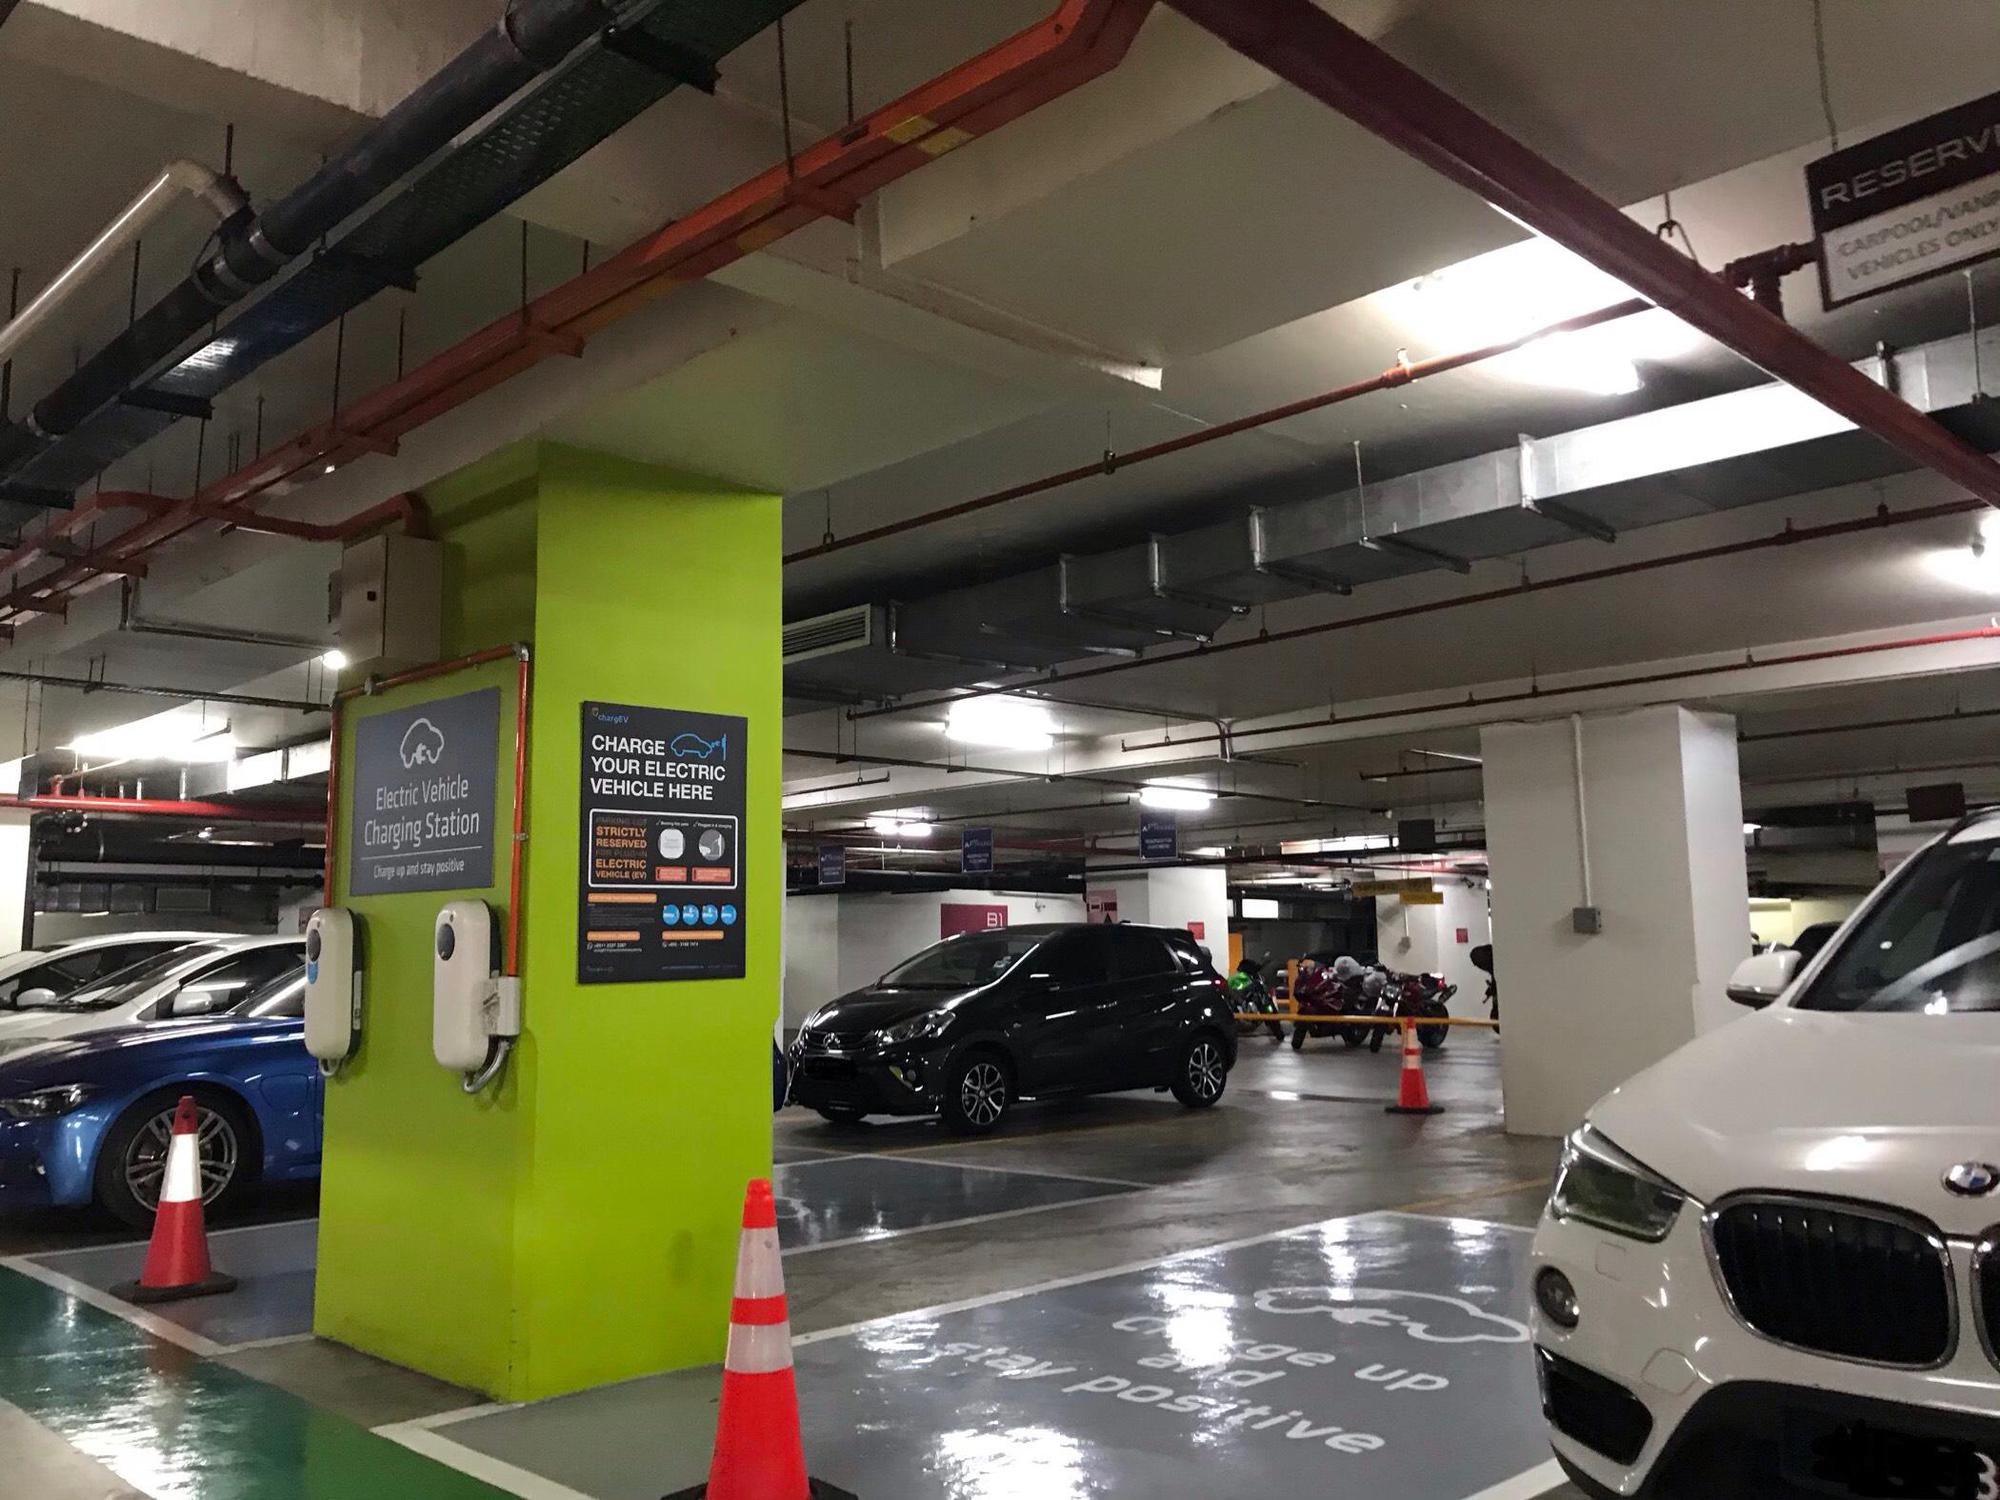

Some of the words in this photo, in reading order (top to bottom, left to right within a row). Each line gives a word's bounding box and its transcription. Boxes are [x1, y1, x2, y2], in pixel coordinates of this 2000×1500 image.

[1847, 238, 1941, 280] VEHICLES
[591, 734, 665, 756] CHARGE
[591, 756, 640, 776] YOUR
[645, 761, 726, 781] ELECTRIC
[376, 783, 419, 810] Electric
[421, 773, 469, 804] Vehicle
[590, 778, 663, 798] VEHICLE
[669, 782, 713, 801] HERE
[364, 816, 422, 850] Charging
[425, 808, 479, 839] Station
[596, 826, 647, 837] STRICTLY
[596, 838, 647, 848] RESERVED
[374, 864, 396, 880] Charge
[397, 865, 405, 878] up
[406, 861, 419, 876] and
[420, 861, 435, 877] stay
[436, 858, 465, 876] positive
[595, 870, 630, 879] VEHICLE
[596, 859, 647, 870] ELECTRIC
[987, 912, 1003, 928] B1
[1112, 1315, 1336, 1367] Crge
[1355, 1363, 1449, 1391] up
[938, 1341, 1078, 1380] stay
[1062, 1375, 1386, 1455] positive
